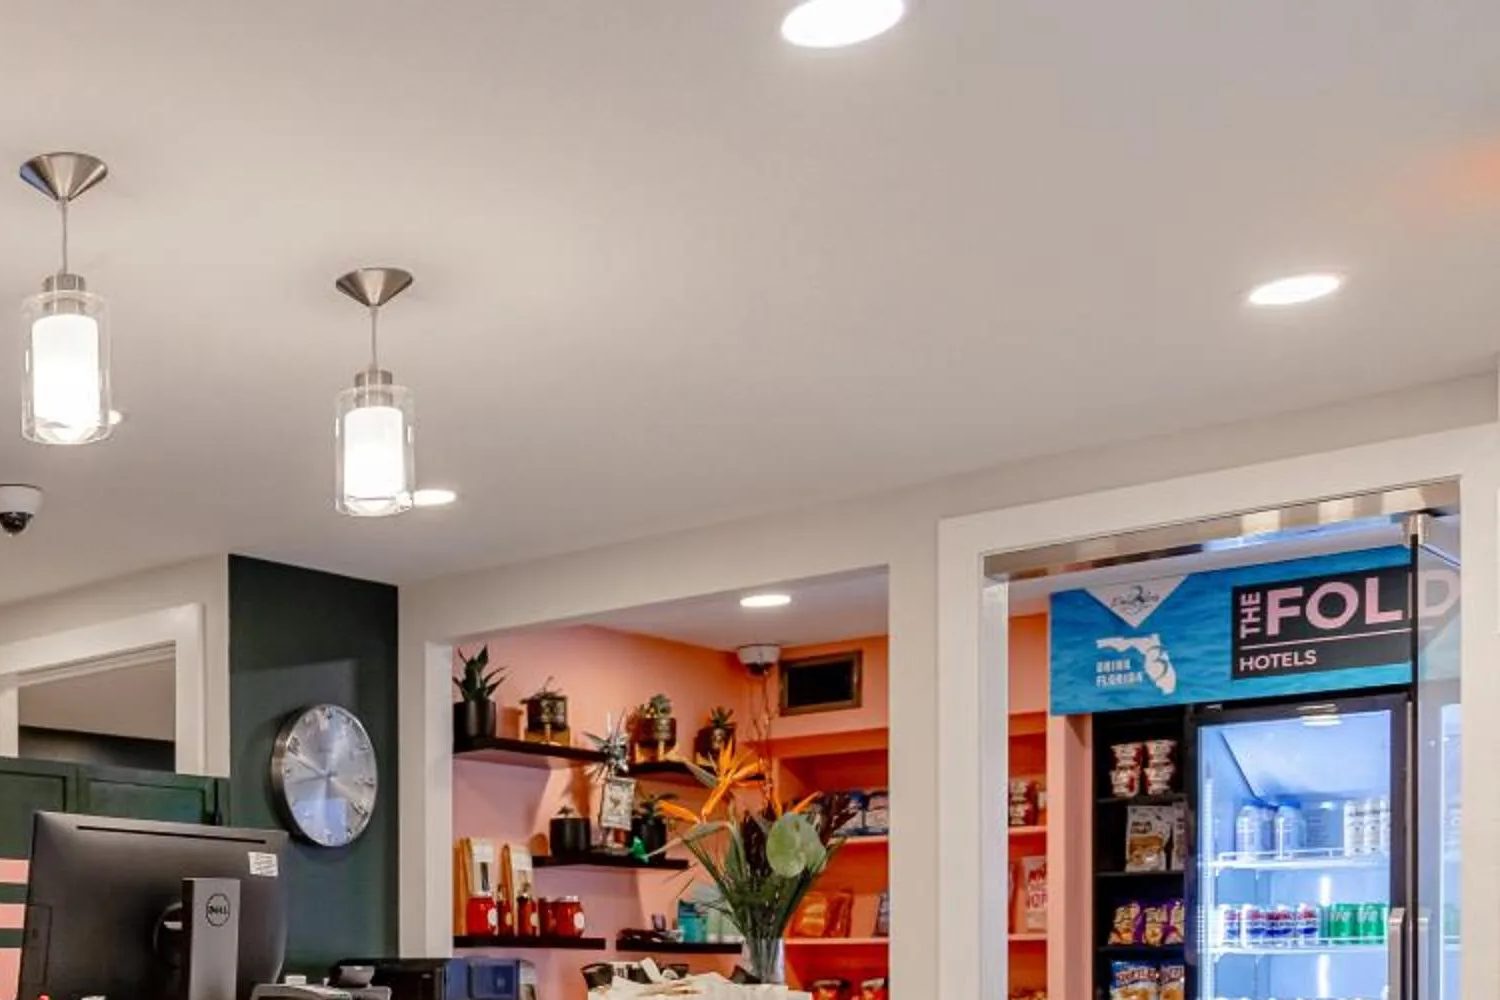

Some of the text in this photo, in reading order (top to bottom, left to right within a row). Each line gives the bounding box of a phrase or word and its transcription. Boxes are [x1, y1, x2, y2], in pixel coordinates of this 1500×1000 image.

[1240, 568, 1461, 639] THE FOLD
[1239, 649, 1317, 672] HOTELS
